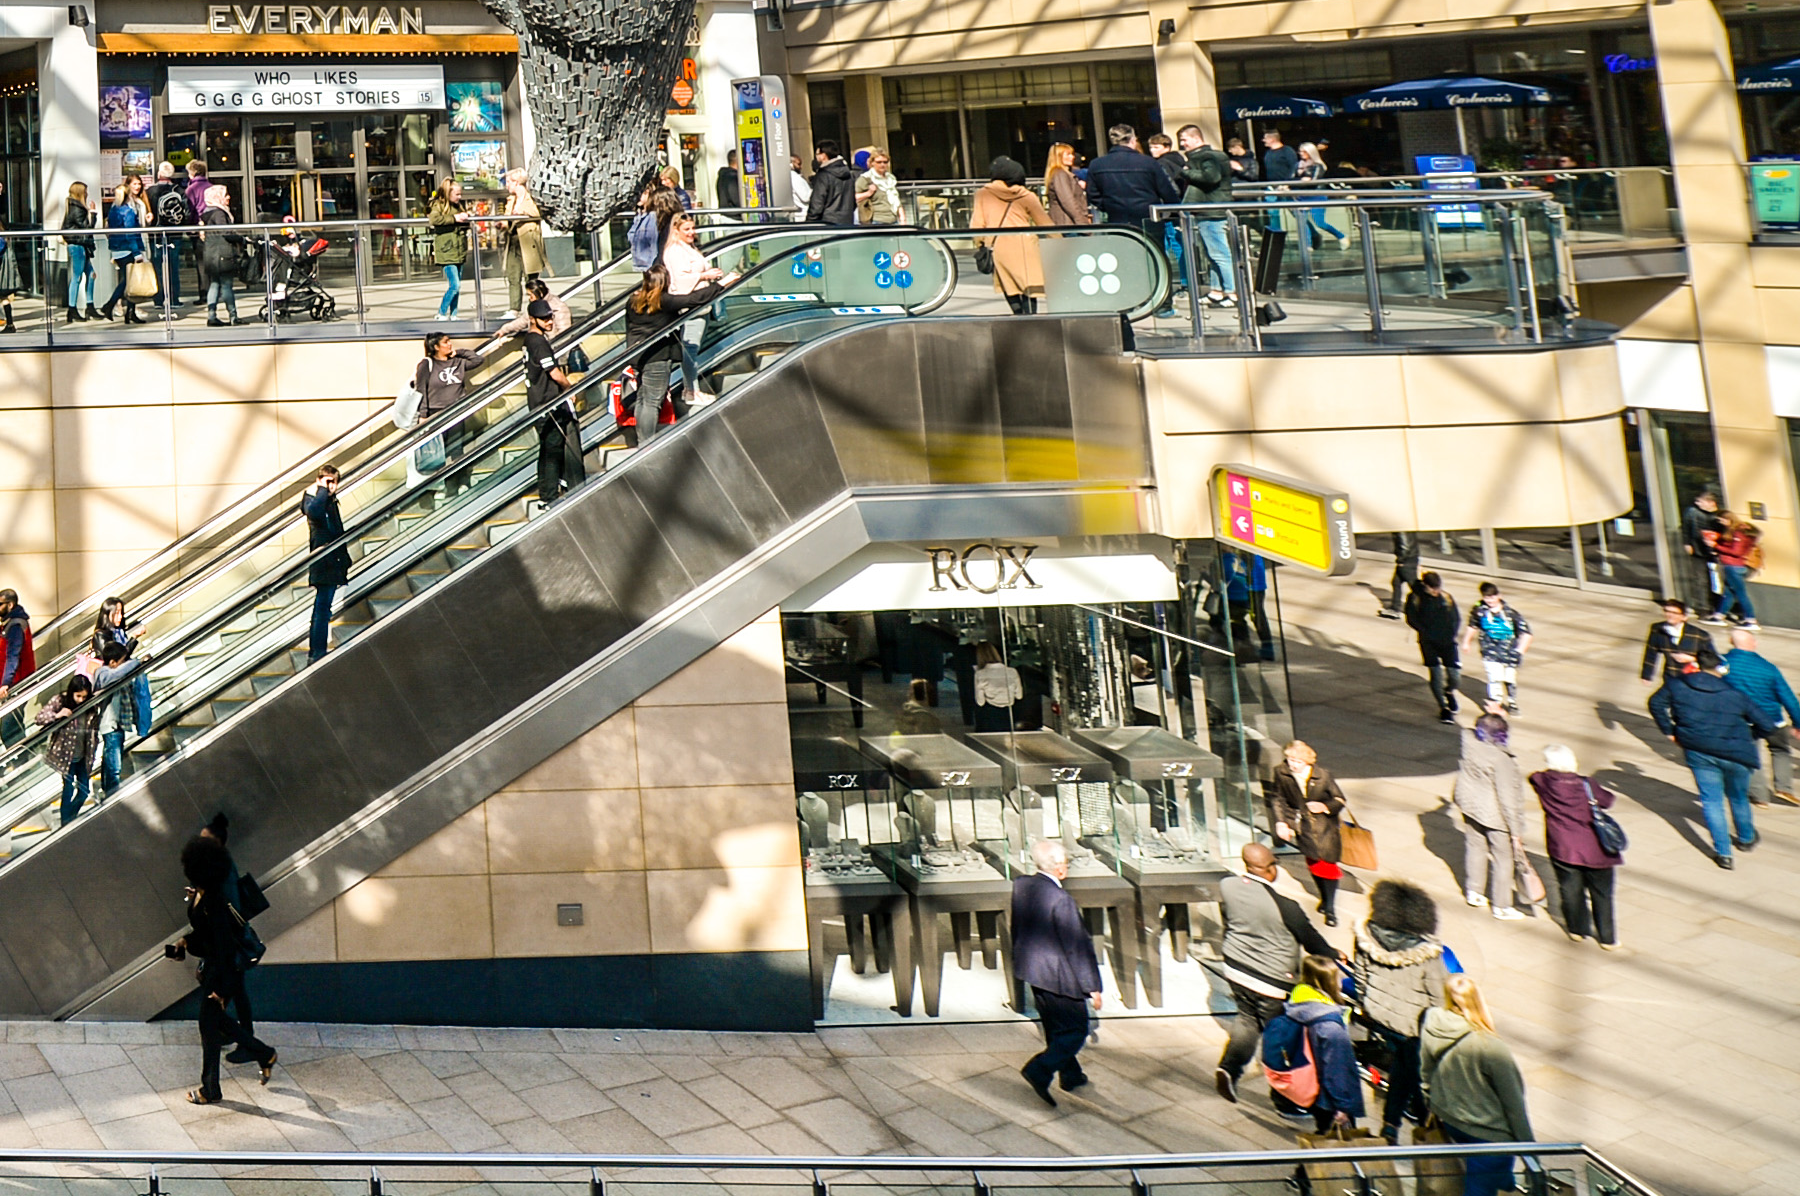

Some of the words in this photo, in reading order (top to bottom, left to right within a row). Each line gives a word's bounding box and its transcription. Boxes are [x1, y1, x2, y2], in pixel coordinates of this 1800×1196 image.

[209, 6, 423, 34] EVERYMAN
[255, 72, 290, 85] WHO
[314, 72, 358, 85] LIKES
[1738, 78, 1792, 89] luccio's
[195, 93, 206, 106] G
[213, 93, 224, 106] G
[231, 93, 242, 106] G
[252, 93, 263, 106] G
[271, 92, 322, 105] GHOST
[336, 91, 400, 104] STORIES
[420, 93, 431, 103] 15
[1358, 97, 1418, 110] Carluccio's
[1446, 93, 1512, 106] Carluccio's
[1236, 106, 1292, 119] Carluccio's
[1335, 520, 1351, 559] Ground
[924, 543, 1043, 594] ROX
[828, 774, 859, 788] ROX
